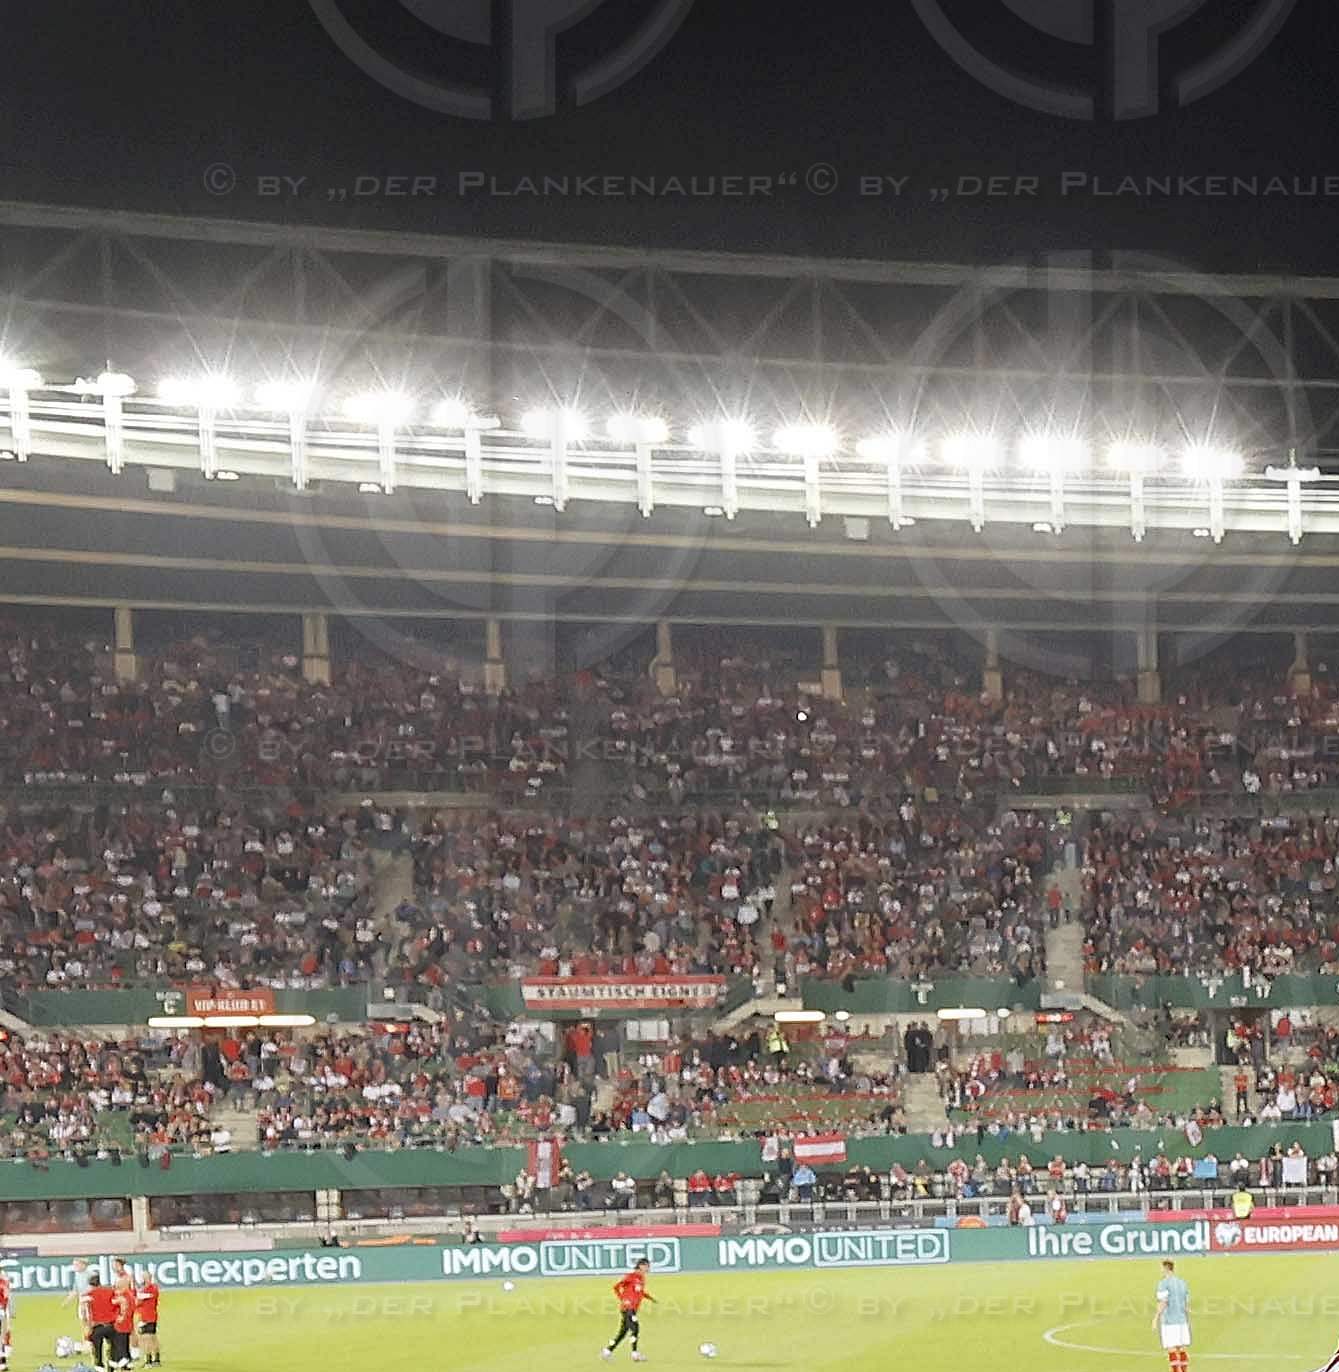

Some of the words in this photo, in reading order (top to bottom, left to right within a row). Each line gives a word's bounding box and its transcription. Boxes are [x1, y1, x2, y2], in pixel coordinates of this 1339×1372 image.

[719, 1238, 811, 1266] IMMO
[821, 1232, 942, 1262] UNITED
[1028, 1223, 1093, 1256] Ihre
[1243, 1224, 1339, 1244] EUROPEAN
[443, 1246, 538, 1275] IMMO
[547, 1241, 673, 1272] UNITED
